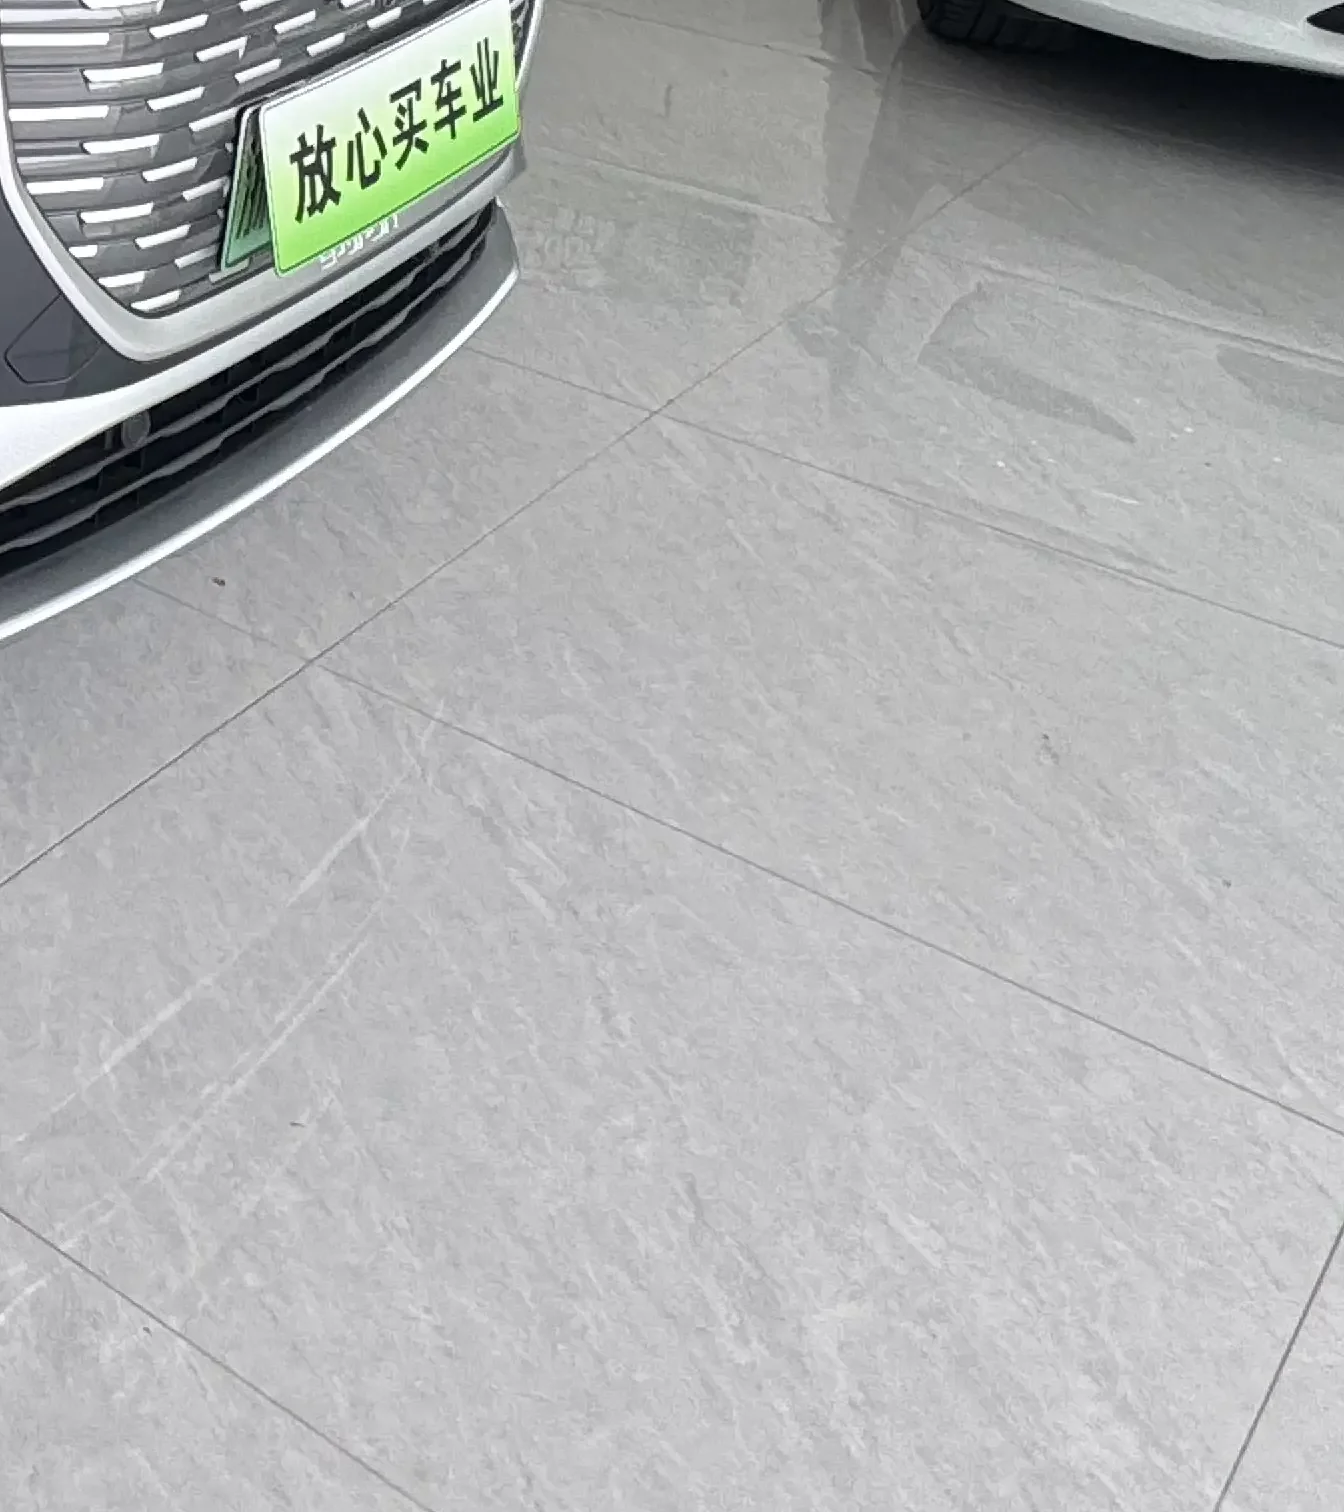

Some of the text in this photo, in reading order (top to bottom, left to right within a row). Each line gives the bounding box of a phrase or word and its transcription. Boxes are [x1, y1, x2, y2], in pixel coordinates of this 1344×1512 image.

[289, 37, 504, 223] 放心买车业
